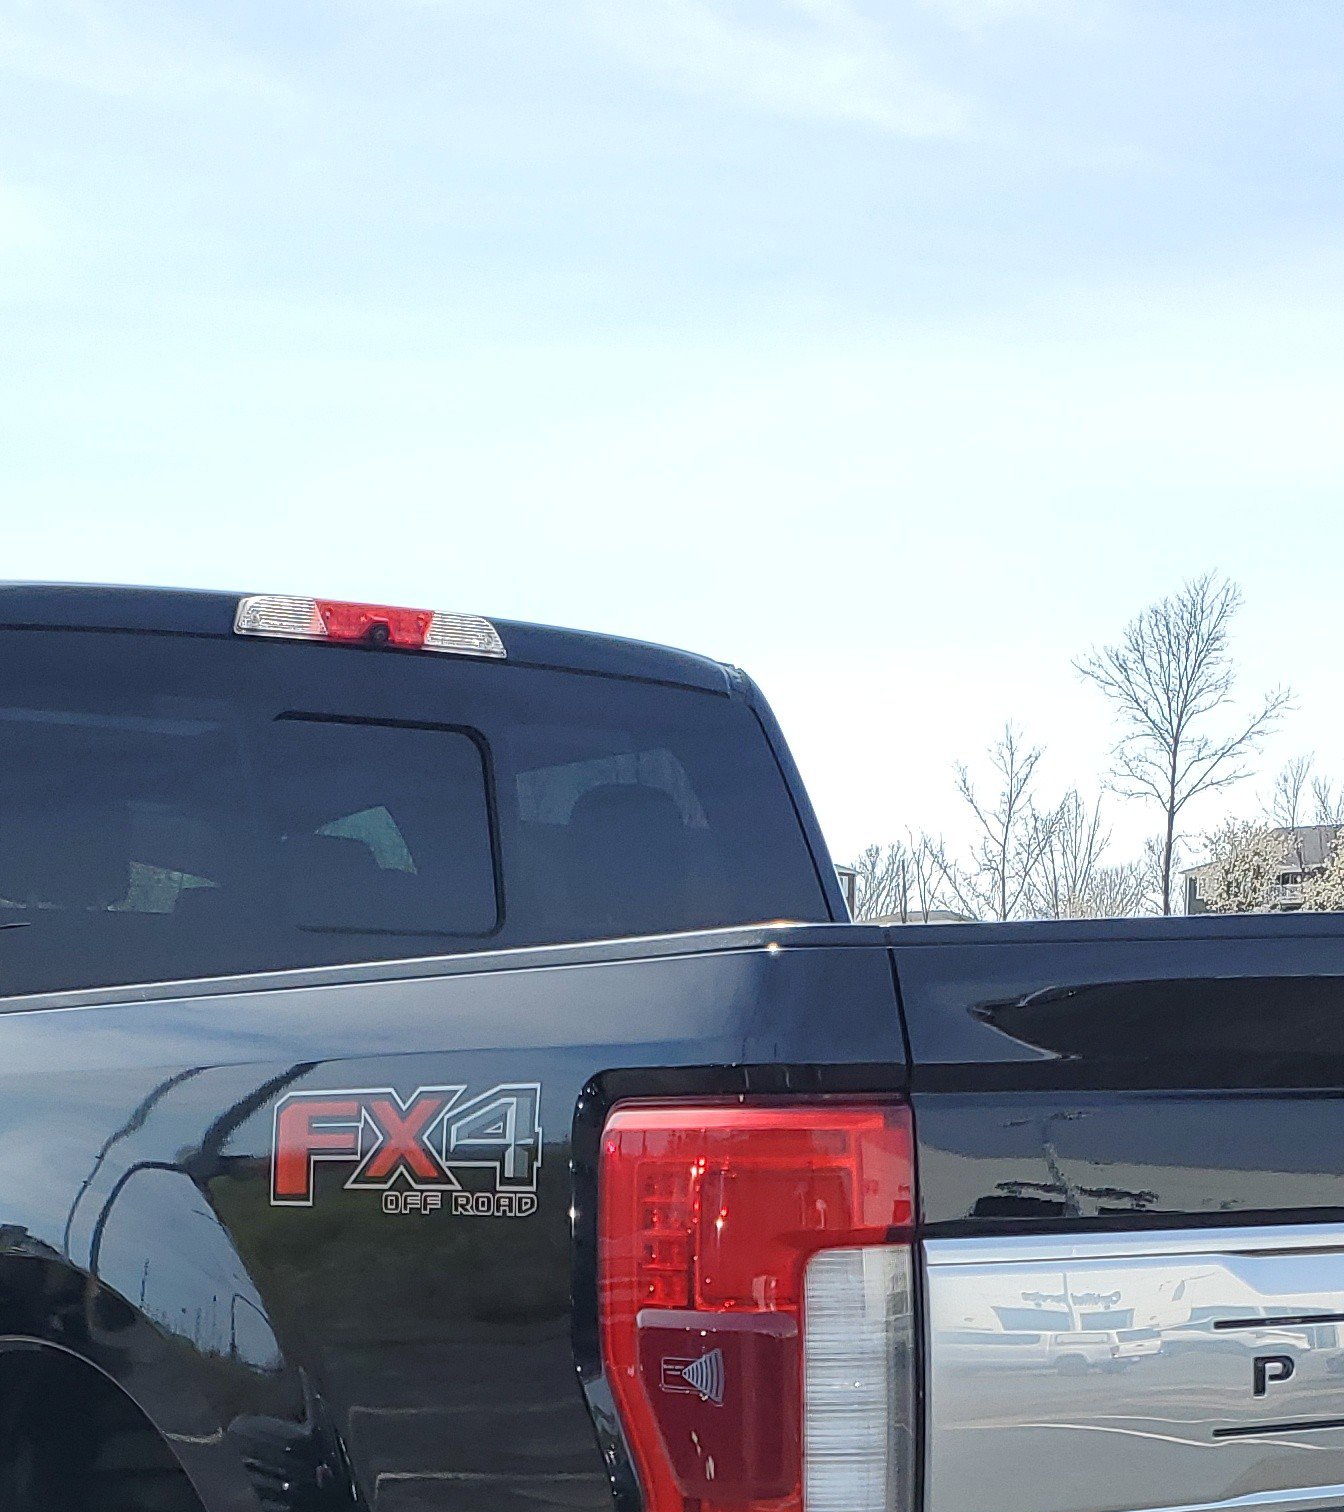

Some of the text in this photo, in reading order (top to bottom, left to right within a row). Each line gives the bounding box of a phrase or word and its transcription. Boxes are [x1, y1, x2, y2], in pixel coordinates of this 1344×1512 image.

[270, 1082, 542, 1207] FX4
[382, 1191, 538, 1217] OFF ROAD
